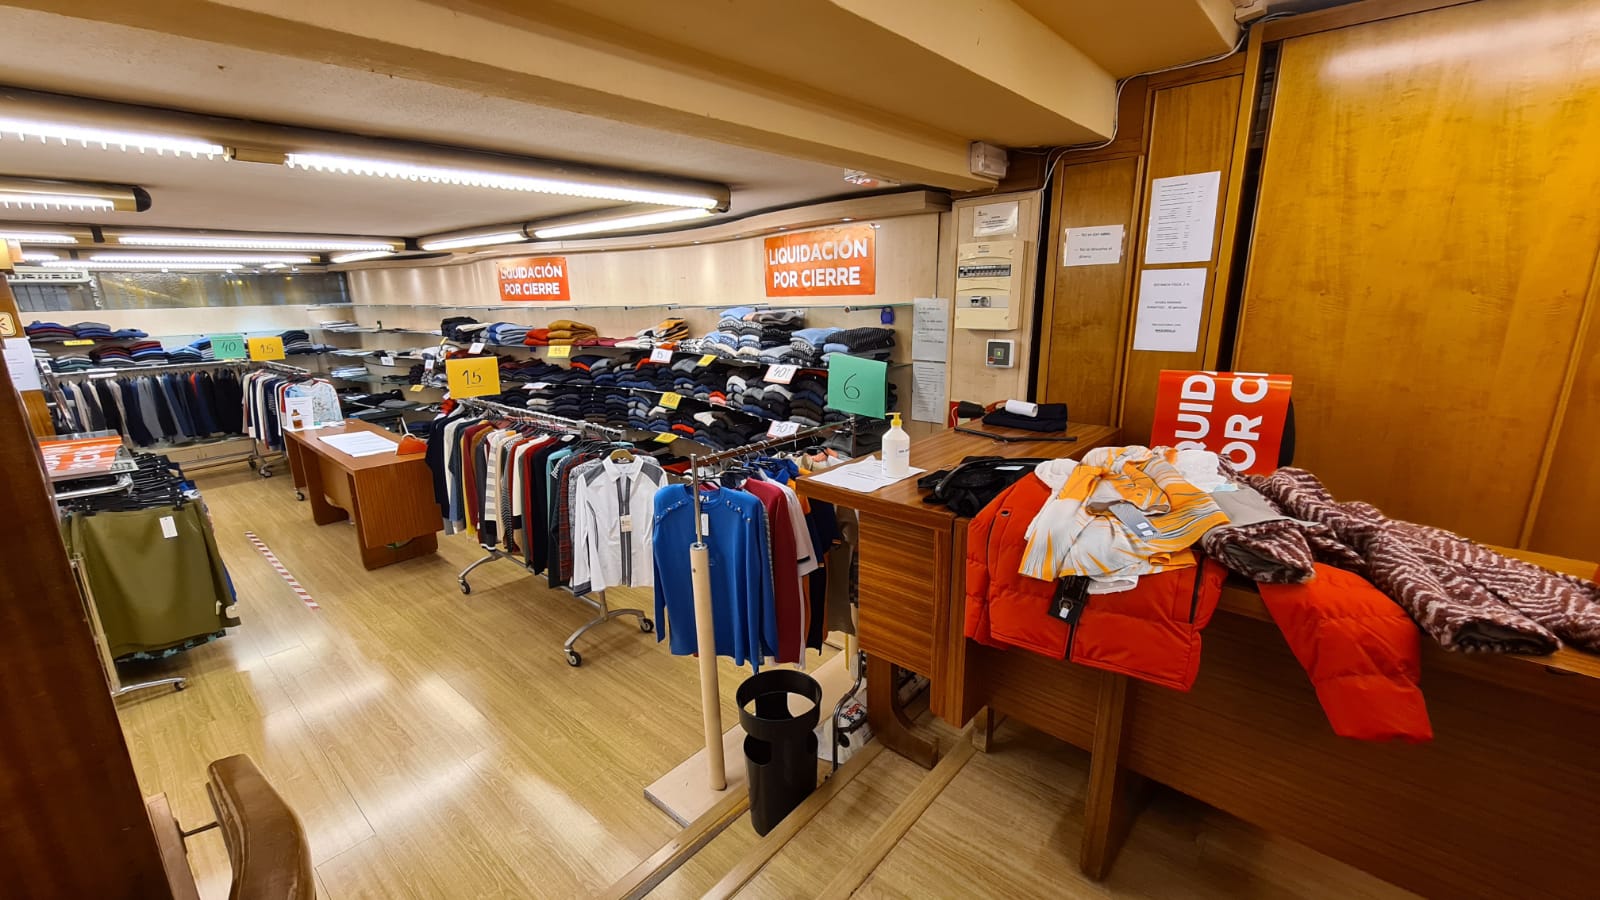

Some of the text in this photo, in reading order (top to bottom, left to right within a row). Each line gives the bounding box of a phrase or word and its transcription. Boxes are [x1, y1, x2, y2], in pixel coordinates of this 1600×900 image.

[768, 234, 868, 265] LIQUIDACIÓN
[500, 262, 563, 279] LIQUIDACIÓN
[773, 266, 861, 288] POR CIERRE
[504, 282, 560, 295] POR CIERRE
[462, 368, 482, 385] 15
[843, 373, 861, 400] 6
